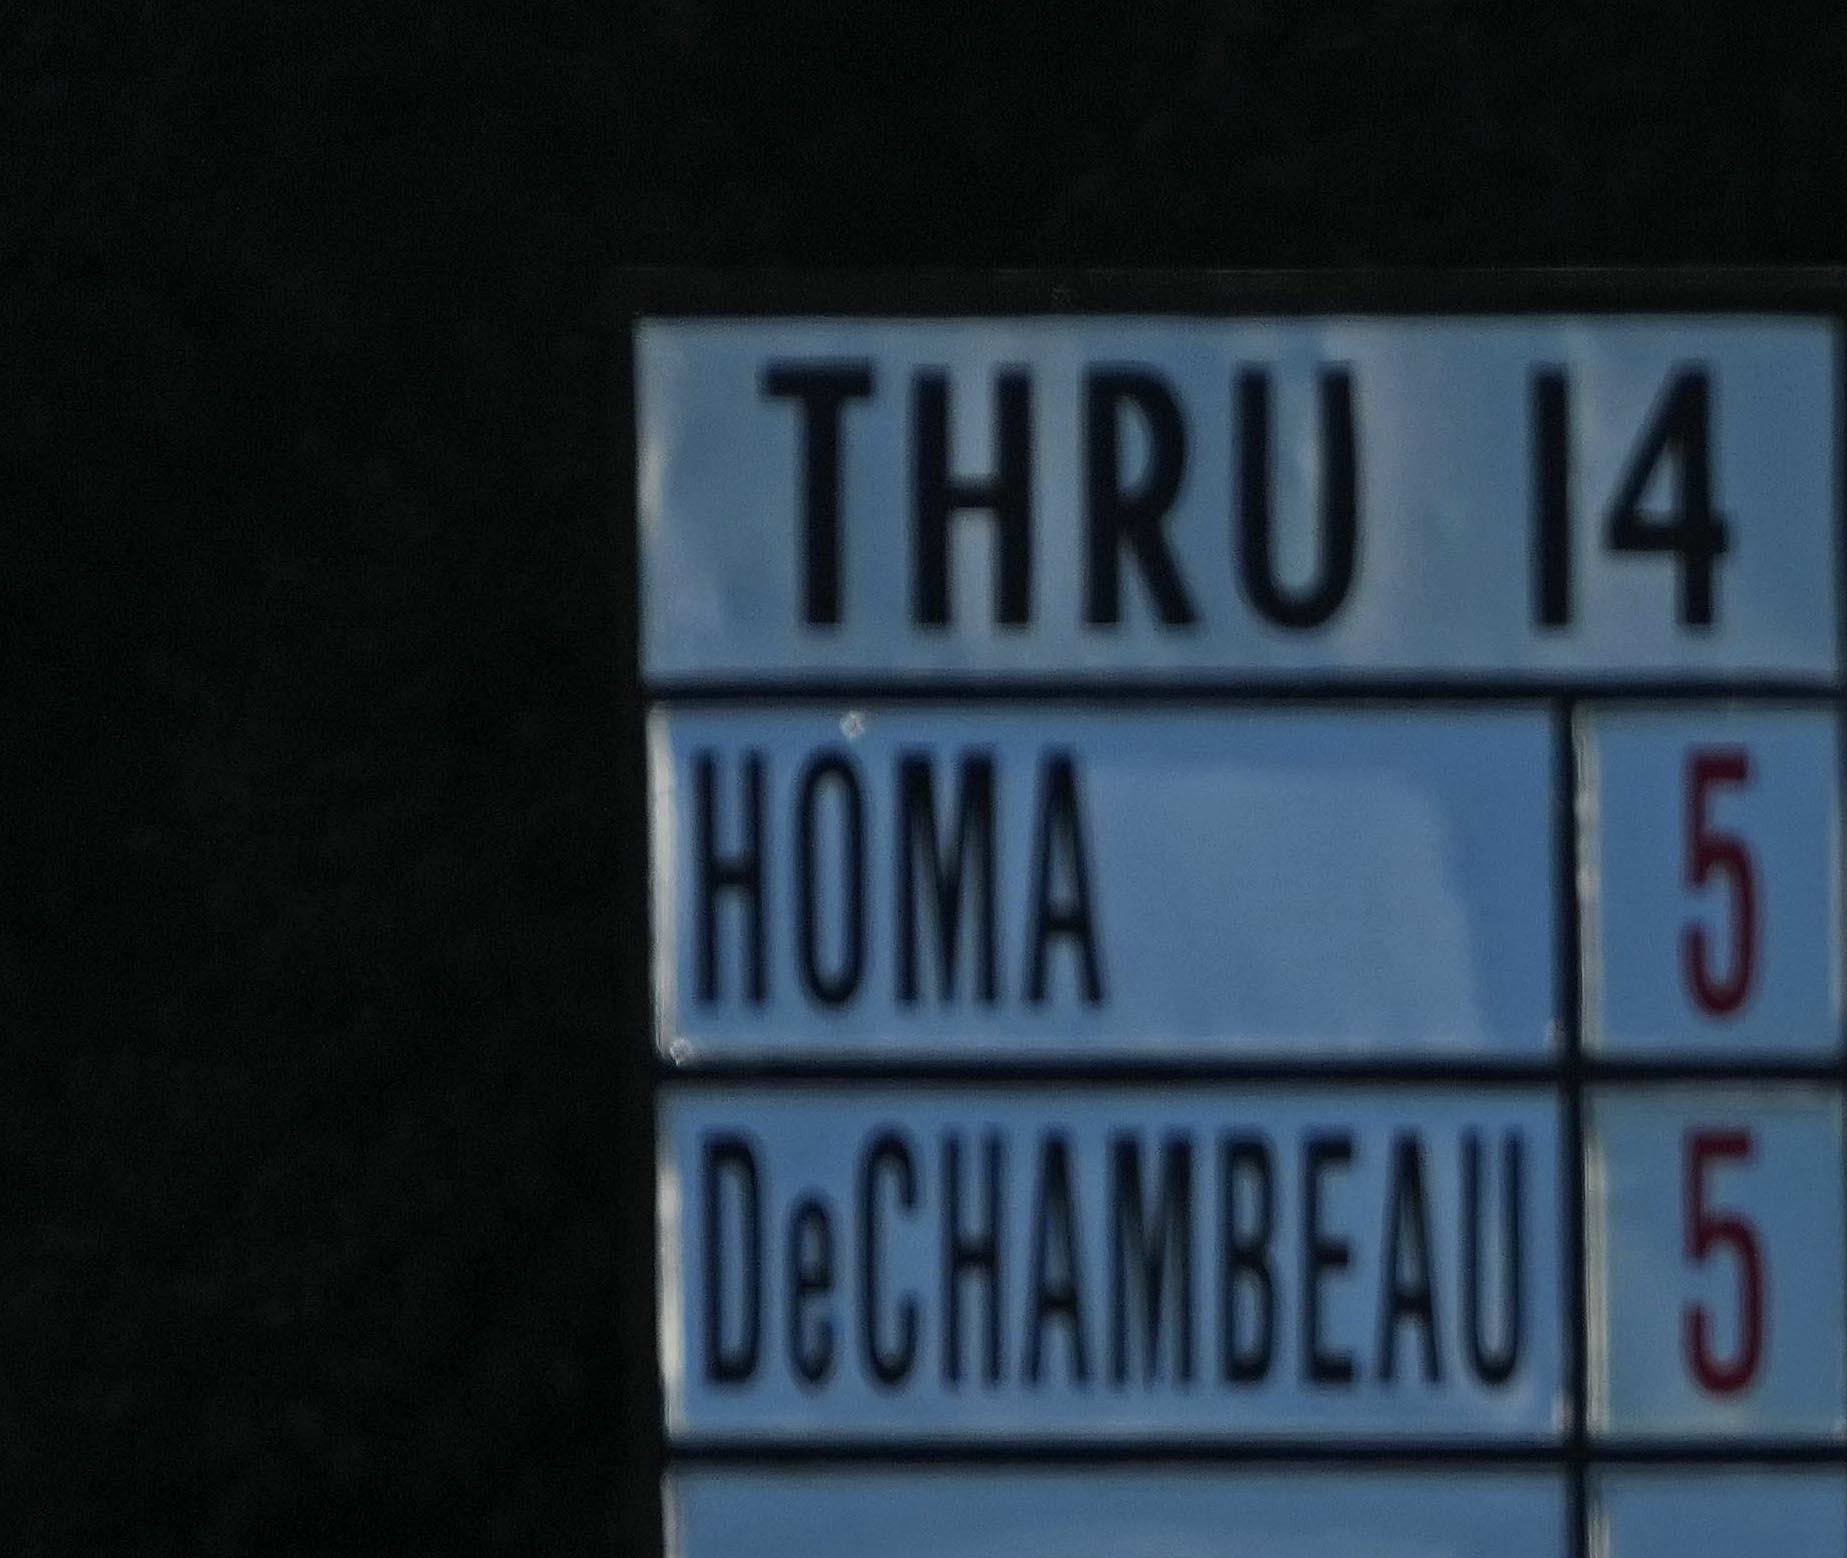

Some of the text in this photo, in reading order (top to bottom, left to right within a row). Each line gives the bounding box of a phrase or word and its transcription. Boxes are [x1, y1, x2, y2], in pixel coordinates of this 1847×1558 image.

[760, 359, 1733, 636] THRU 14
[692, 746, 1105, 1013] HOMA
[1681, 747, 1760, 1018] 5
[699, 1127, 1529, 1392] DeCHAMBEAU
[1682, 1127, 1764, 1400] 5
